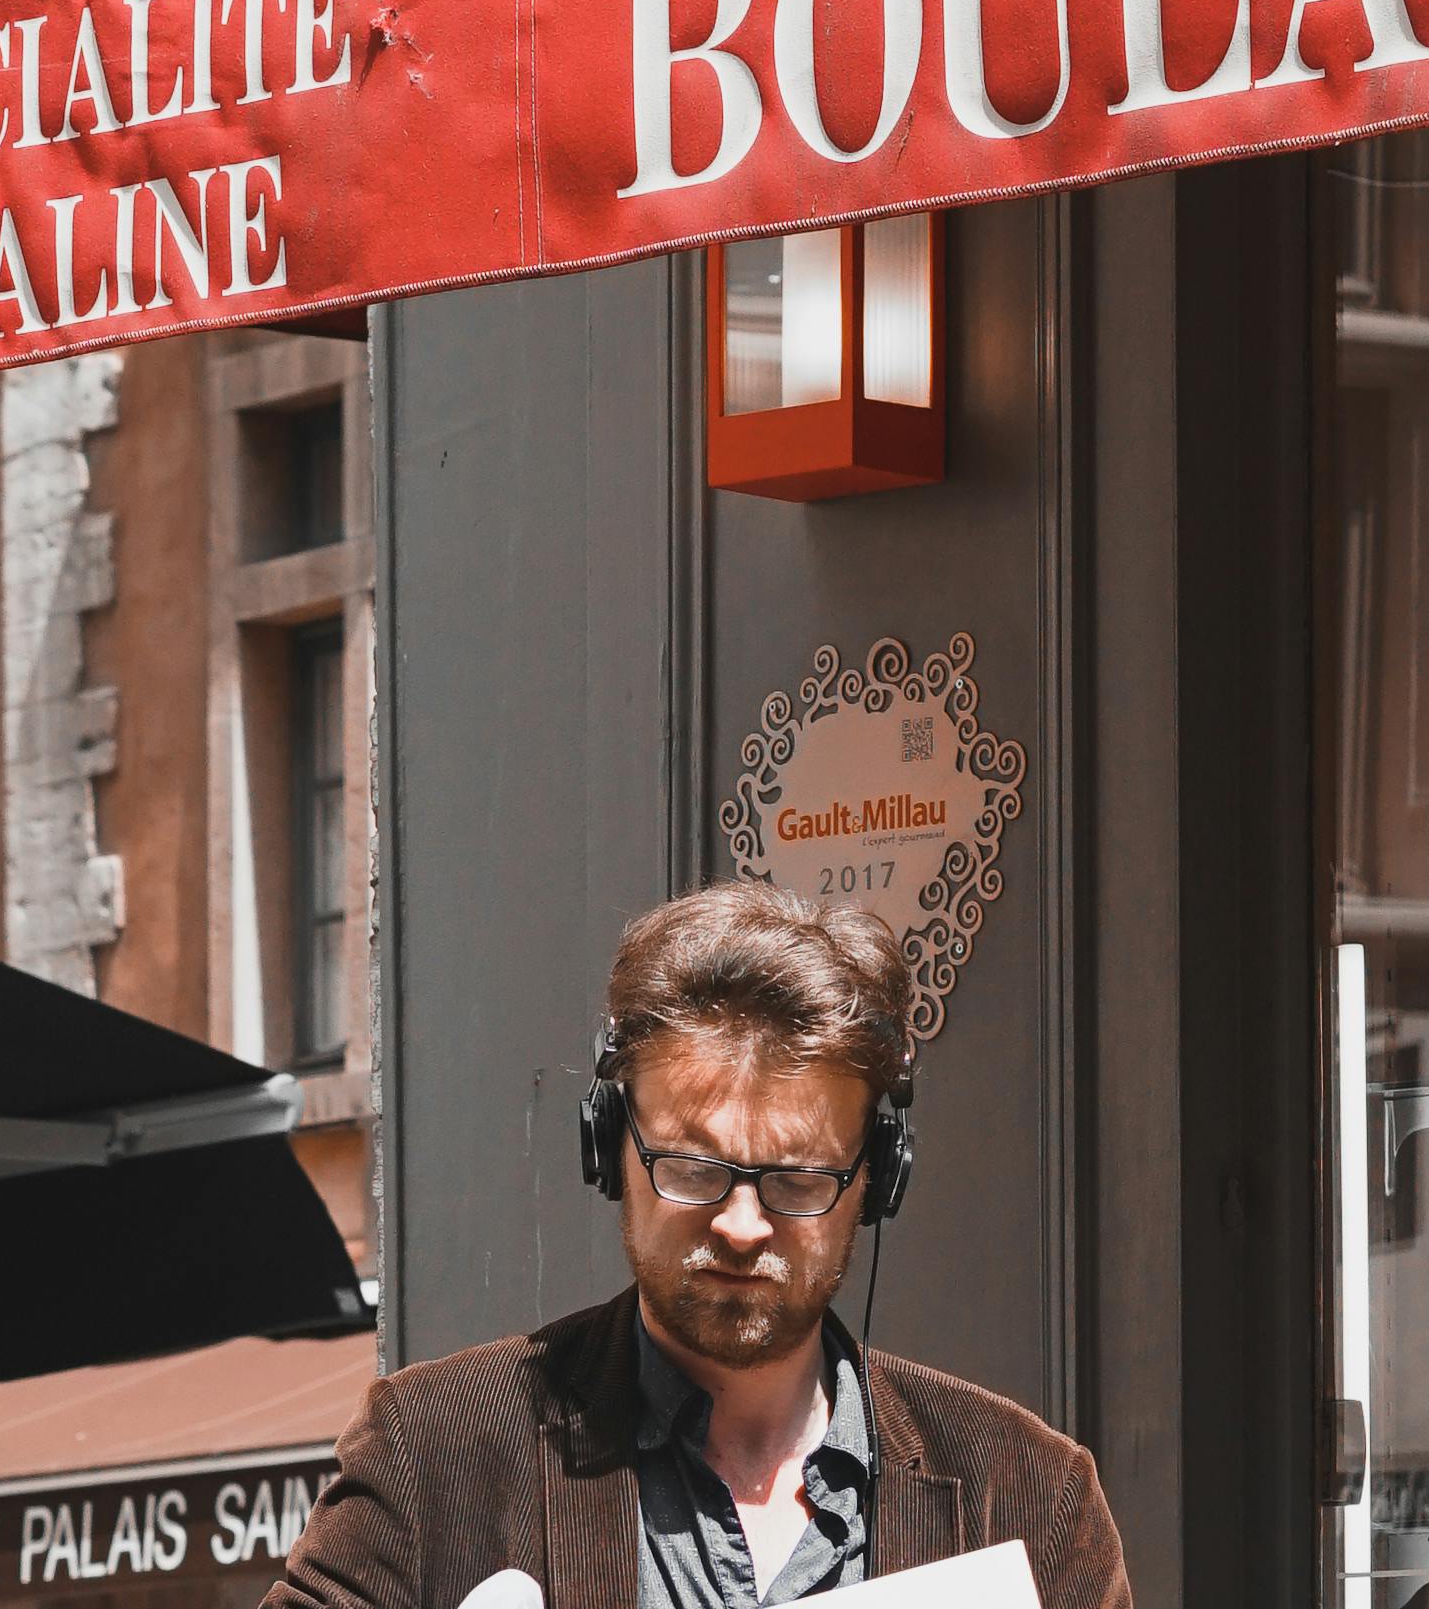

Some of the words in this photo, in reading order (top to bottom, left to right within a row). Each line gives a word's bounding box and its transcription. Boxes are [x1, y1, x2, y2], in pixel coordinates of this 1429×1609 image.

[777, 793, 947, 842] Gault&Millau
[819, 860, 896, 895] 2017
[19, 1490, 189, 1585] PALAIS
